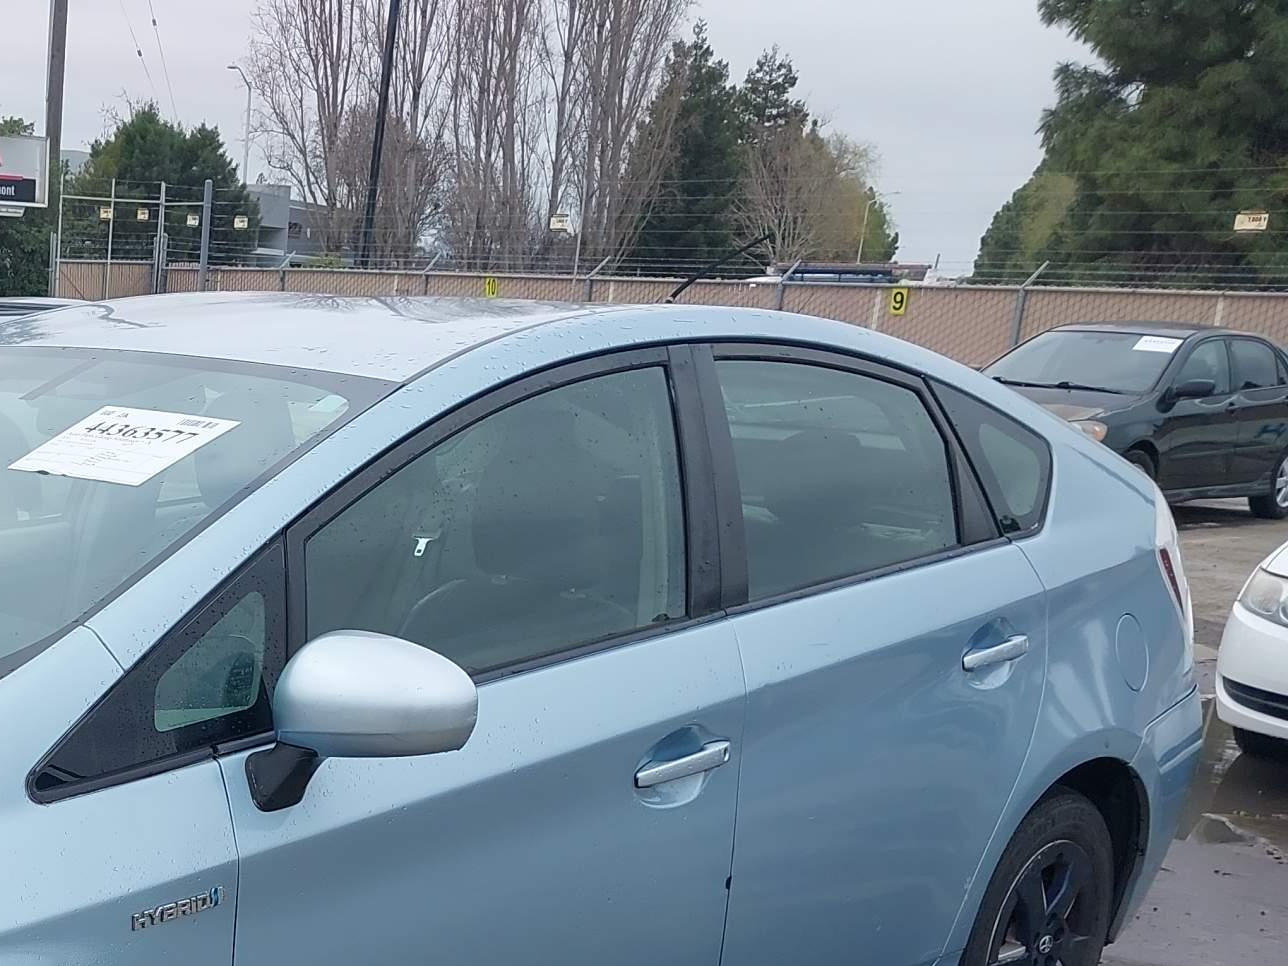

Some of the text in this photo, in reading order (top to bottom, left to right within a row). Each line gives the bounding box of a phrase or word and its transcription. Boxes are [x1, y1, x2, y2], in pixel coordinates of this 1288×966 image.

[892, 291, 905, 311] 9
[85, 421, 200, 444] 44363577
[131, 891, 210, 931] HYBRID
